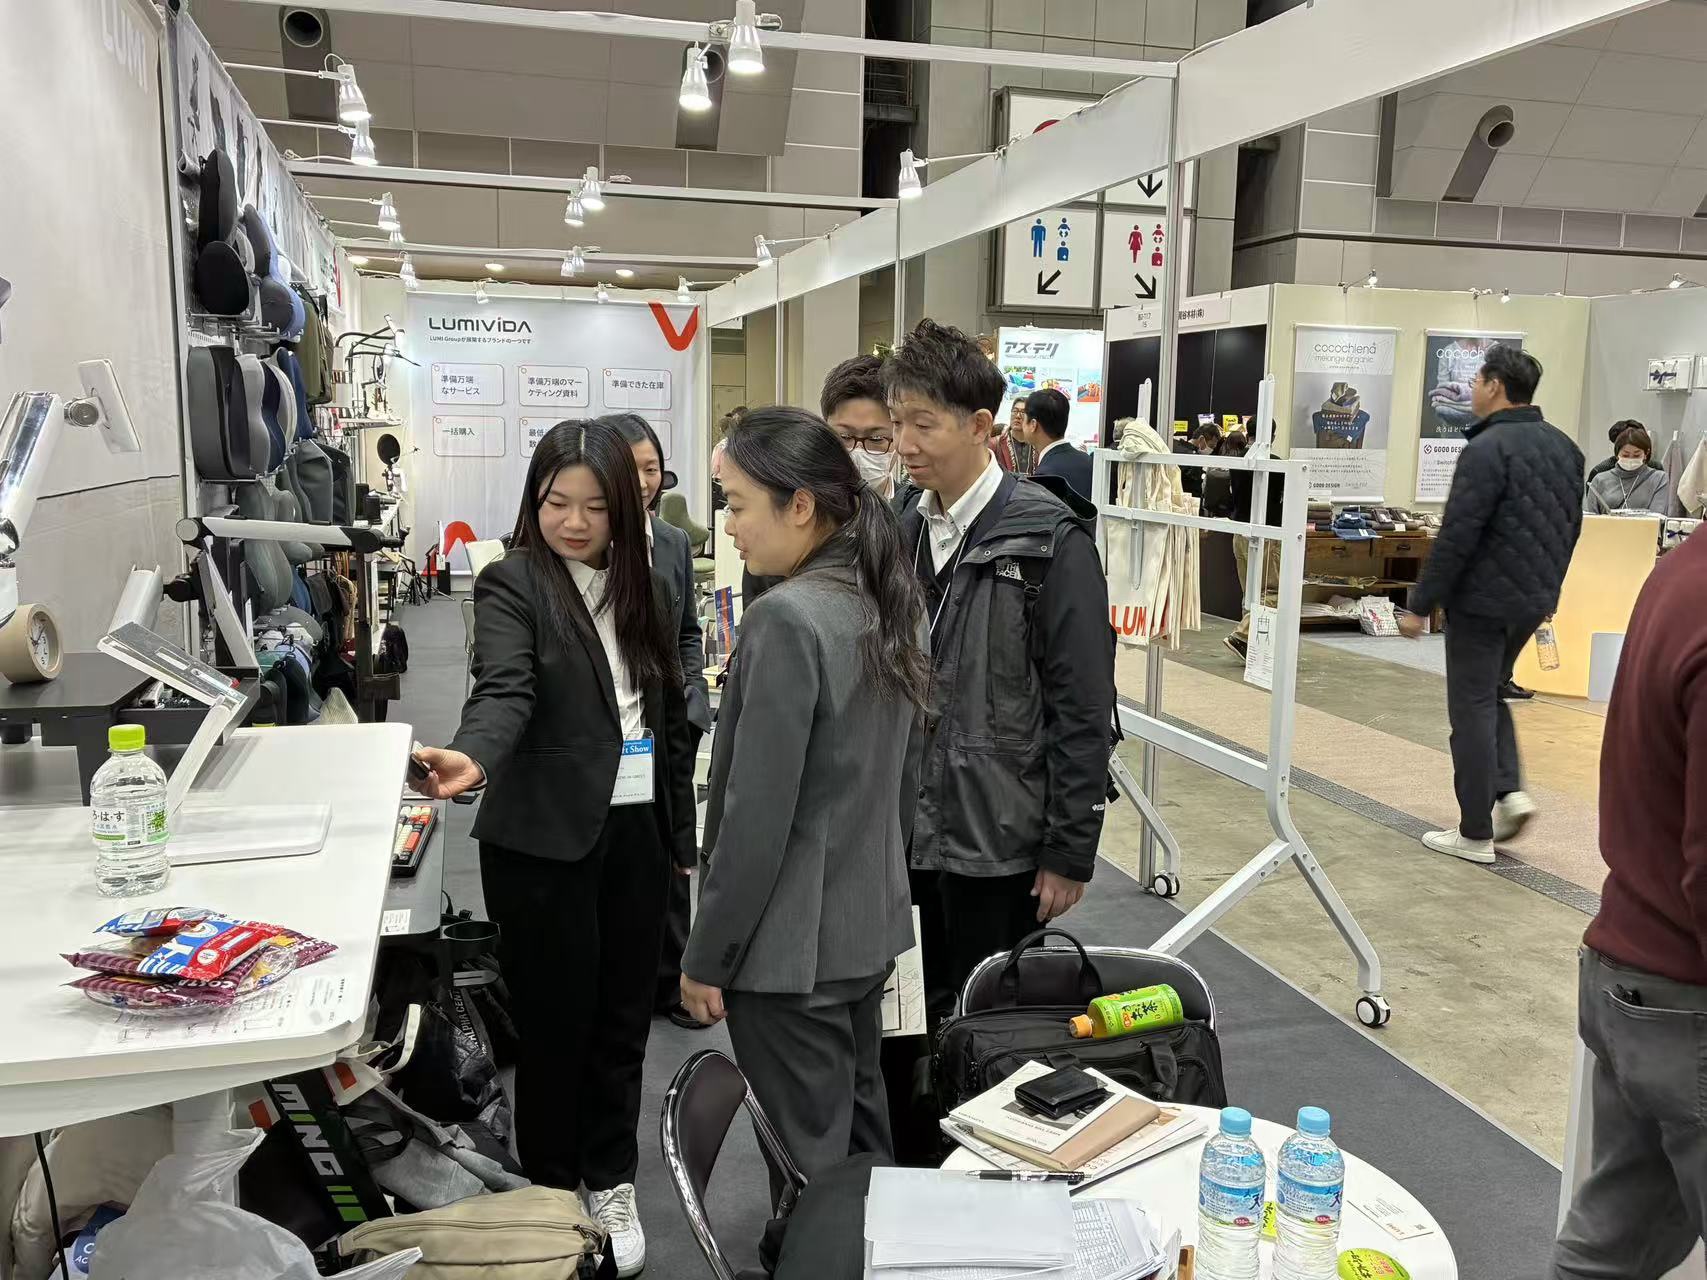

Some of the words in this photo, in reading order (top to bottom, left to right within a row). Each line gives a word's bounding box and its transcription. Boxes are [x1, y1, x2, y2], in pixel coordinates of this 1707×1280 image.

[441, 375, 475, 384] 準備万端
[528, 377, 583, 387] 準備万端のマー
[611, 380, 665, 390] 準備できた在庫
[441, 387, 481, 396] なサービス
[528, 388, 578, 398] ケティング資料
[442, 427, 475, 437] 一括購入
[629, 745, 649, 753] Show
